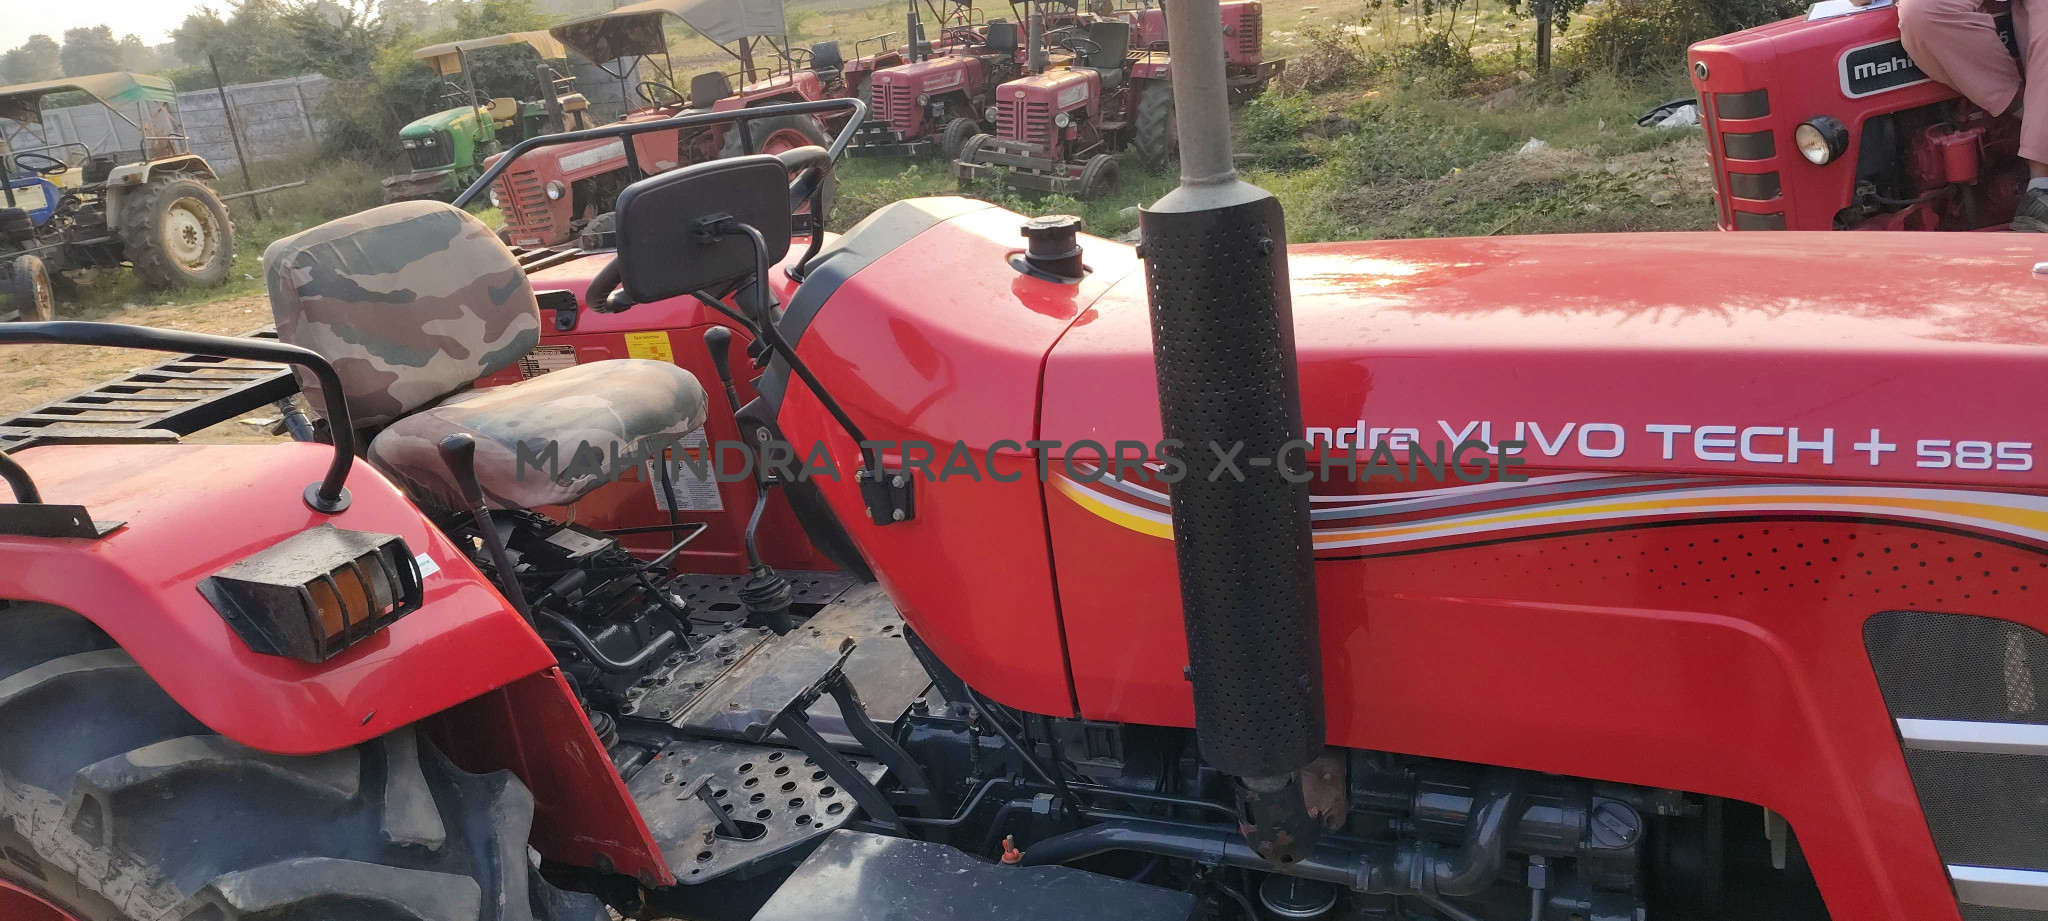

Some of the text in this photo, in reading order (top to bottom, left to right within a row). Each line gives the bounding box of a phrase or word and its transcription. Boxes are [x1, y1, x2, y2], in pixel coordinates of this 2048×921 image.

[1437, 420, 1625, 458] YUVO
[1645, 423, 1834, 465] TECH
[1916, 439, 2034, 471] 585
